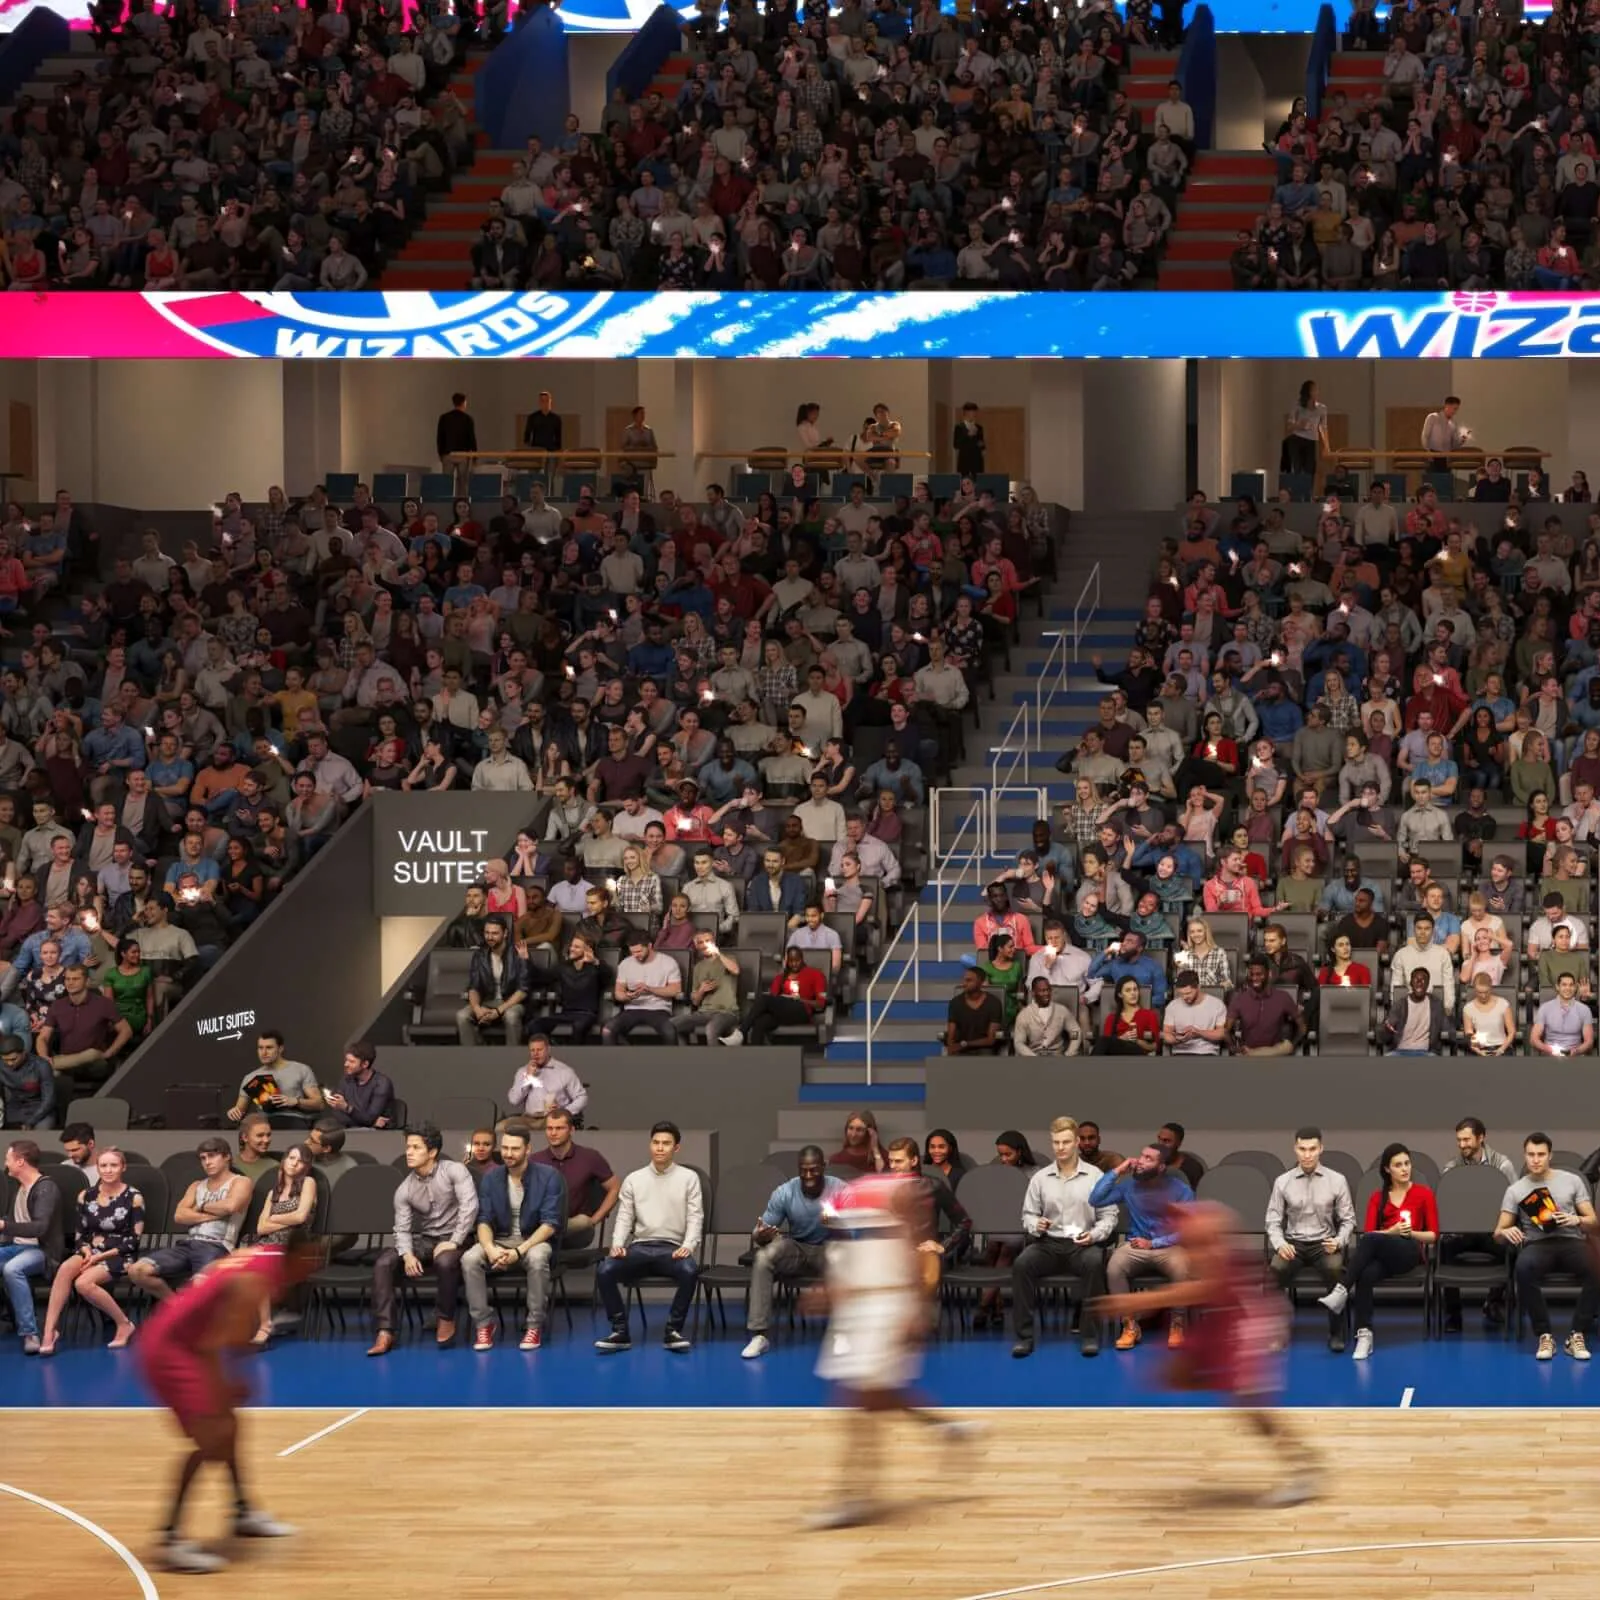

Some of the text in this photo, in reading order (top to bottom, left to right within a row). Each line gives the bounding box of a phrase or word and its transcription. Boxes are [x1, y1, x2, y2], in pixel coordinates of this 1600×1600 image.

[274, 291, 570, 357] WIZARDS
[397, 830, 489, 853] VAULT
[196, 1010, 256, 1036] VAULT SUITES
